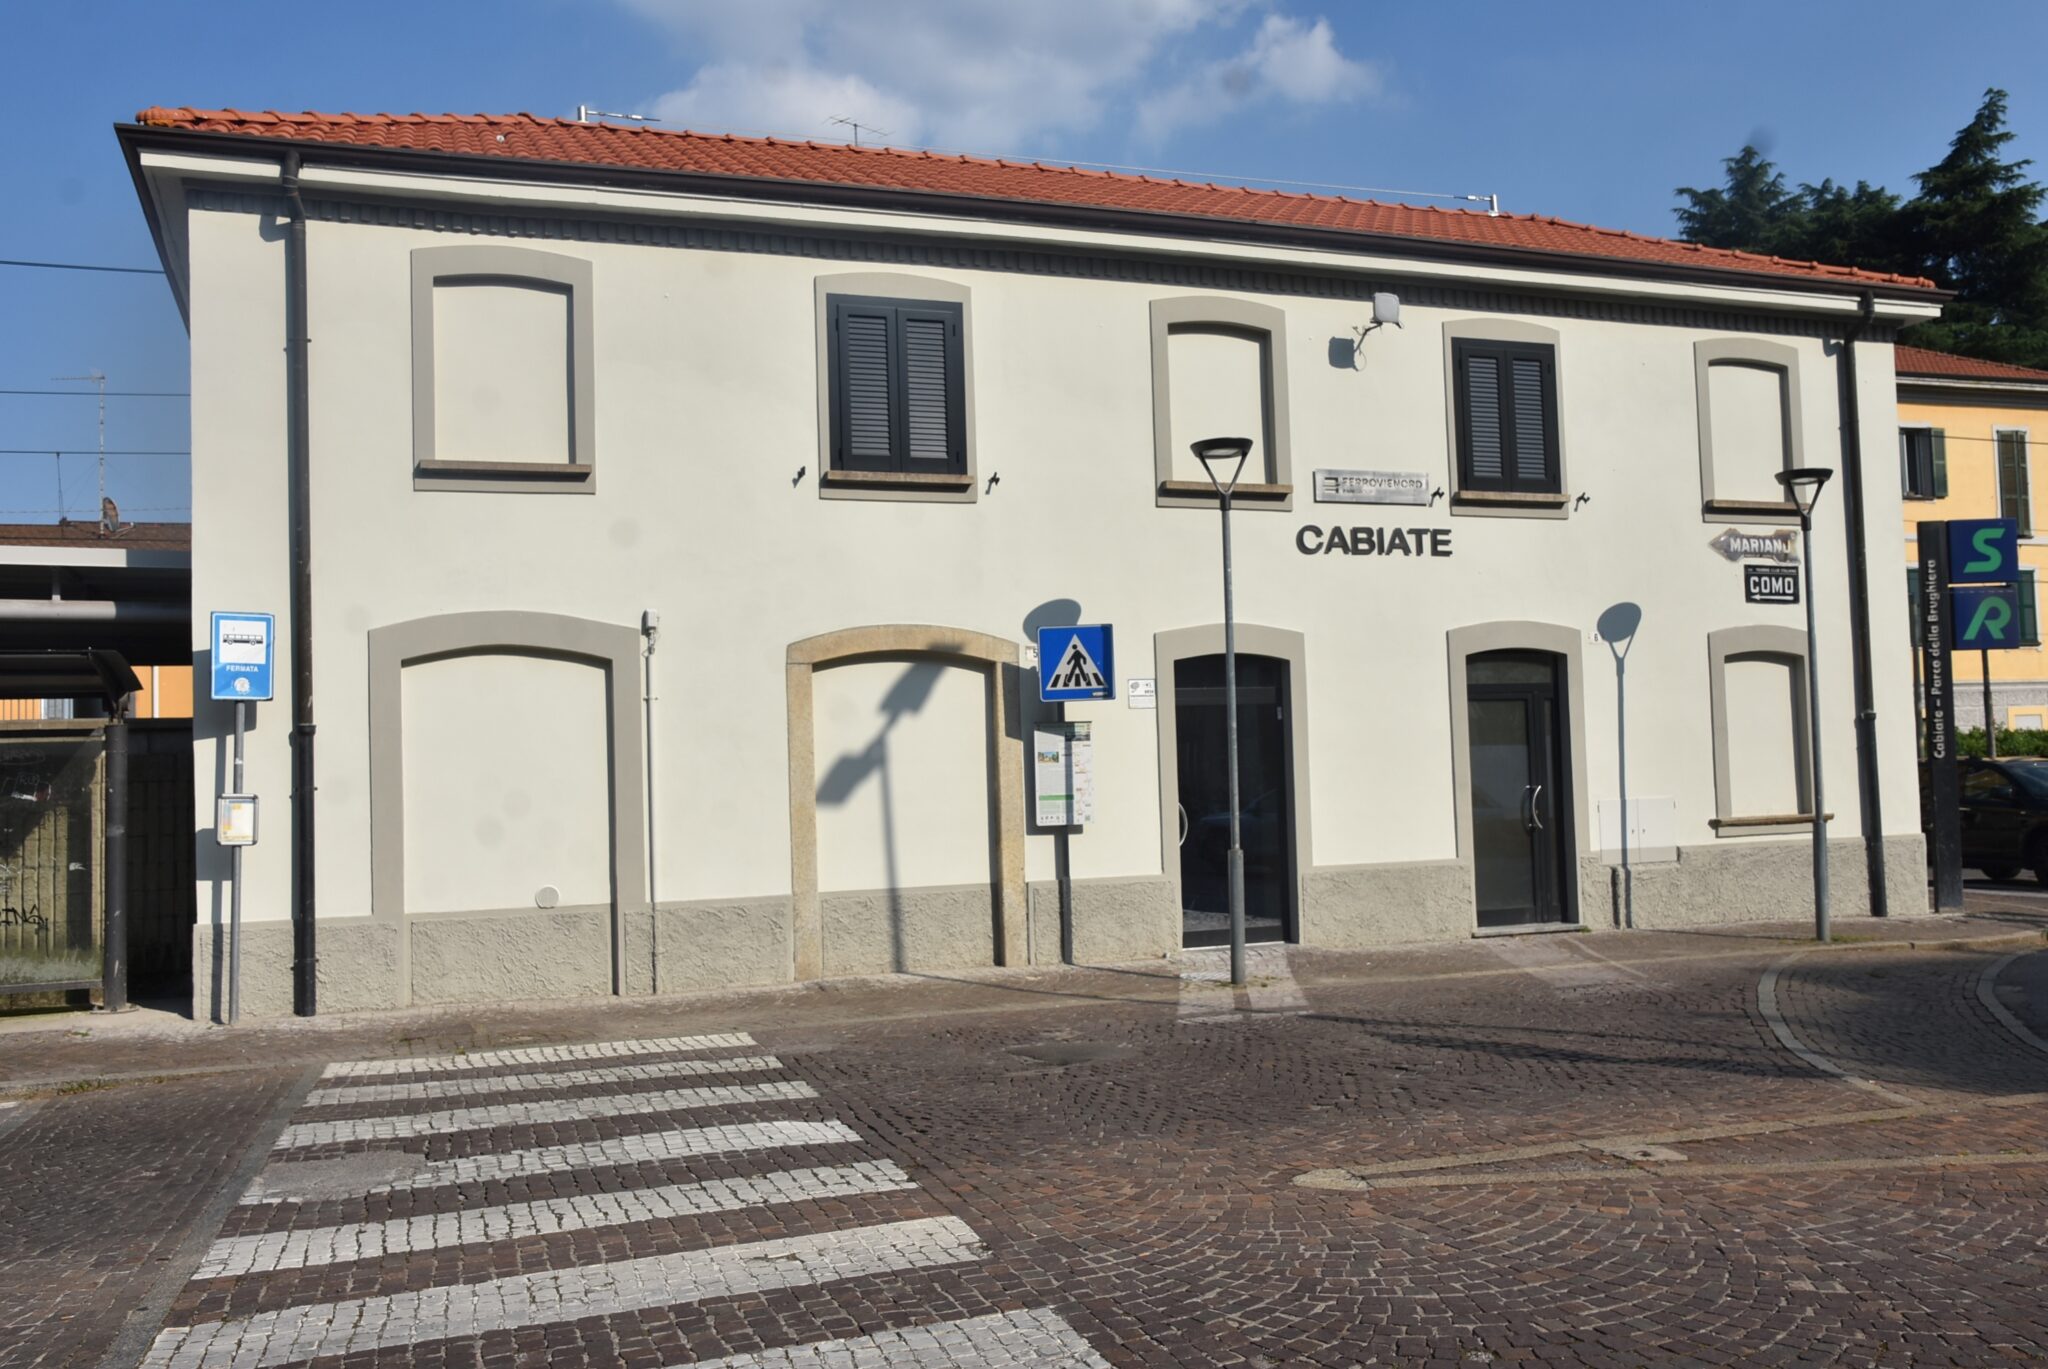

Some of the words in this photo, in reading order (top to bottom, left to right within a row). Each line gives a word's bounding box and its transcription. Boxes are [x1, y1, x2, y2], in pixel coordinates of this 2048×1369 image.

[1341, 476, 1423, 489] FERROVIENORD
[1296, 525, 1453, 557] CABIATE
[1963, 528, 2006, 573] S
[1749, 576, 1794, 594] COMO
[1925, 560, 1941, 621] Brughiera
[1963, 596, 2012, 640] R
[1927, 625, 1941, 657] della
[225, 664, 260, 672] FERMATA
[1930, 660, 1943, 695] Parco
[1932, 710, 1946, 758] Cabiate
